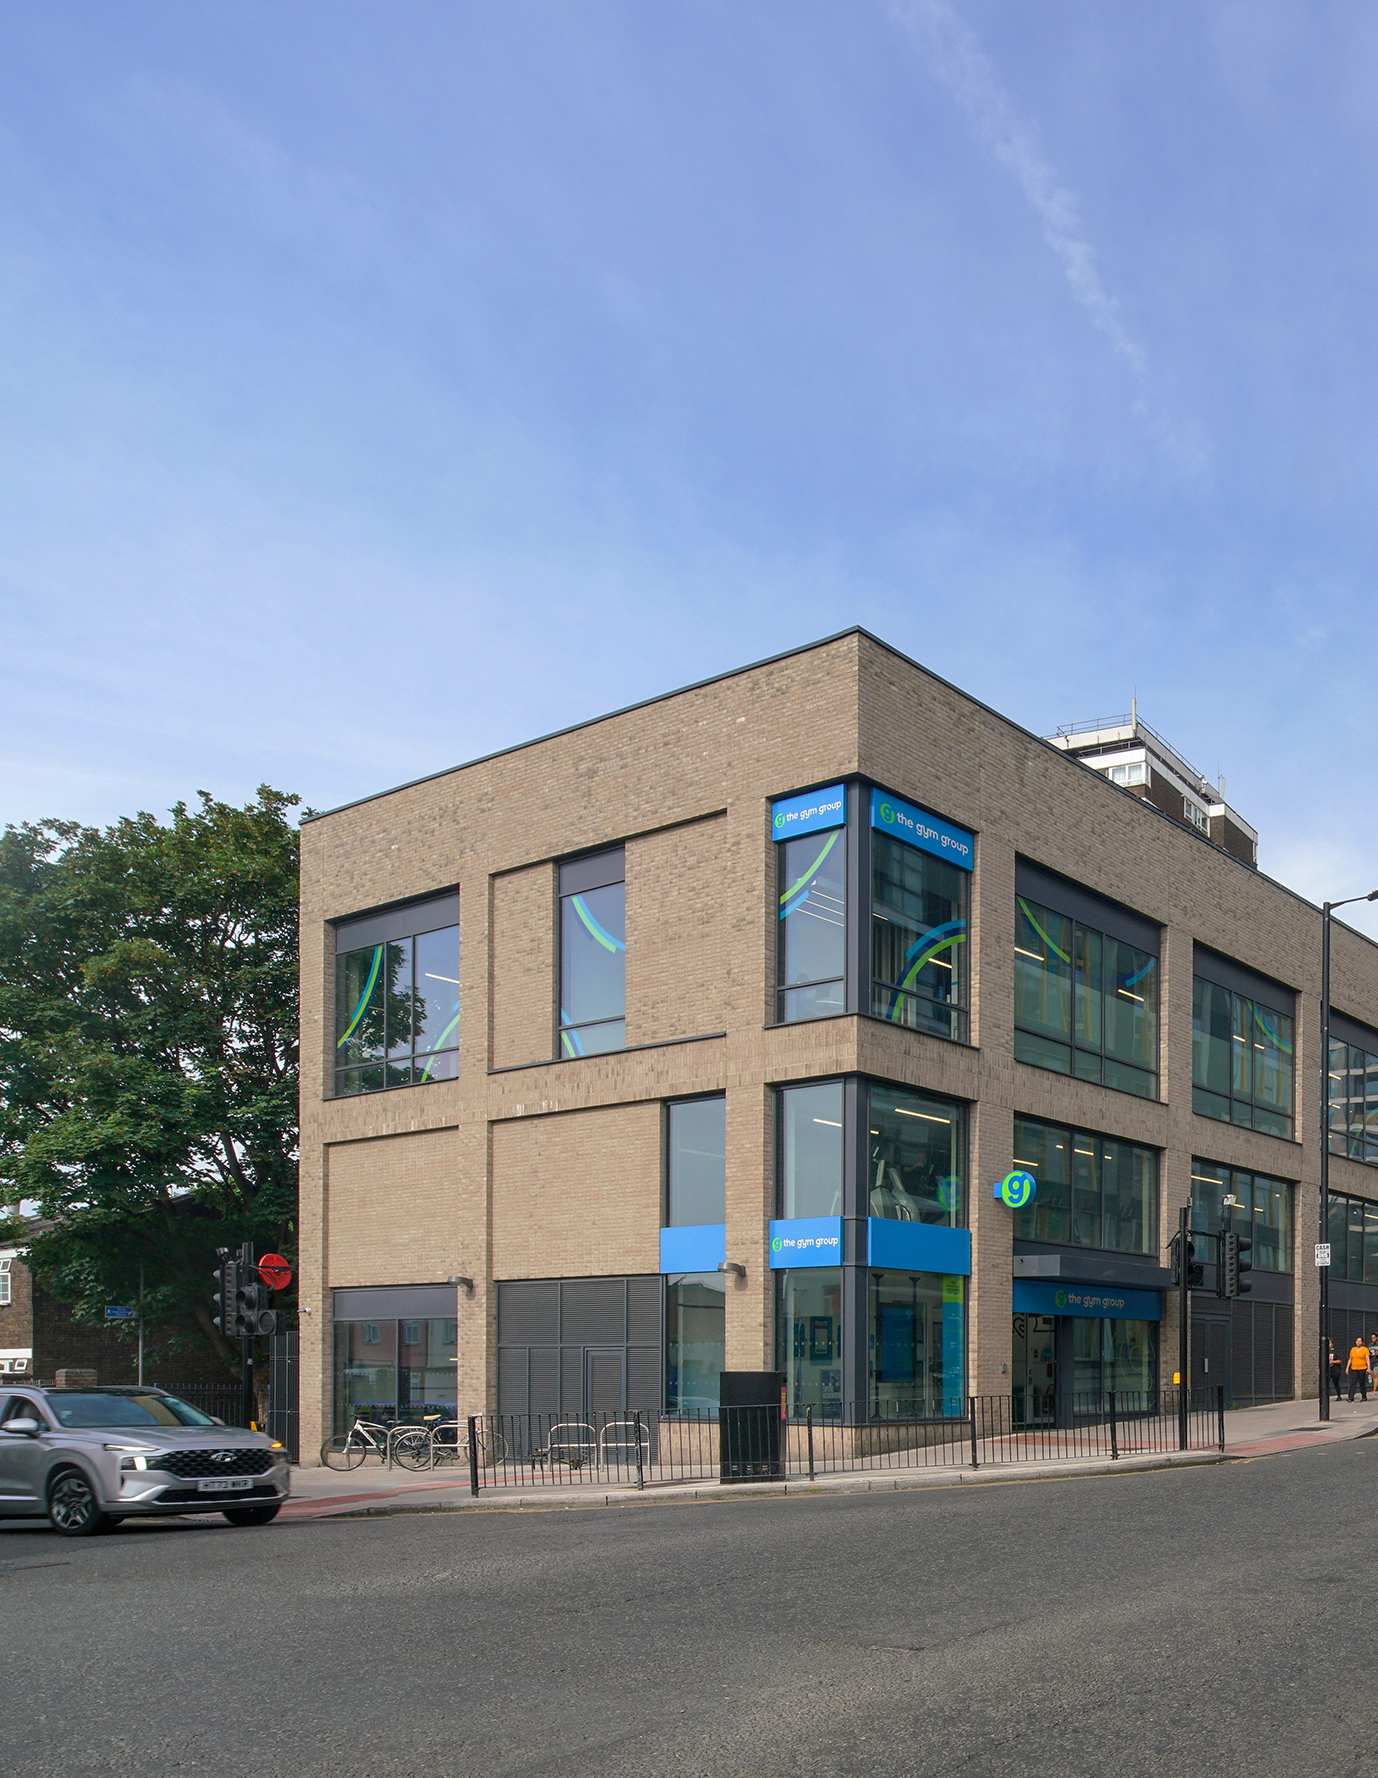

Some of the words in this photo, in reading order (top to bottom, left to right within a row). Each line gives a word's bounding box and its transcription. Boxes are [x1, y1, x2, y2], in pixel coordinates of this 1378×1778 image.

[786, 812, 799, 821] the
[800, 807, 817, 820] gym
[818, 800, 842, 815] group
[896, 812, 914, 828] the
[916, 823, 939, 839] gym
[941, 835, 969, 856] group
[783, 1238, 796, 1248] the
[797, 1238, 815, 1249] gym
[815, 1237, 839, 1248] group
[1068, 1293, 1082, 1304] the
[1083, 1296, 1101, 1308] gym
[1102, 1298, 1125, 1309] group
